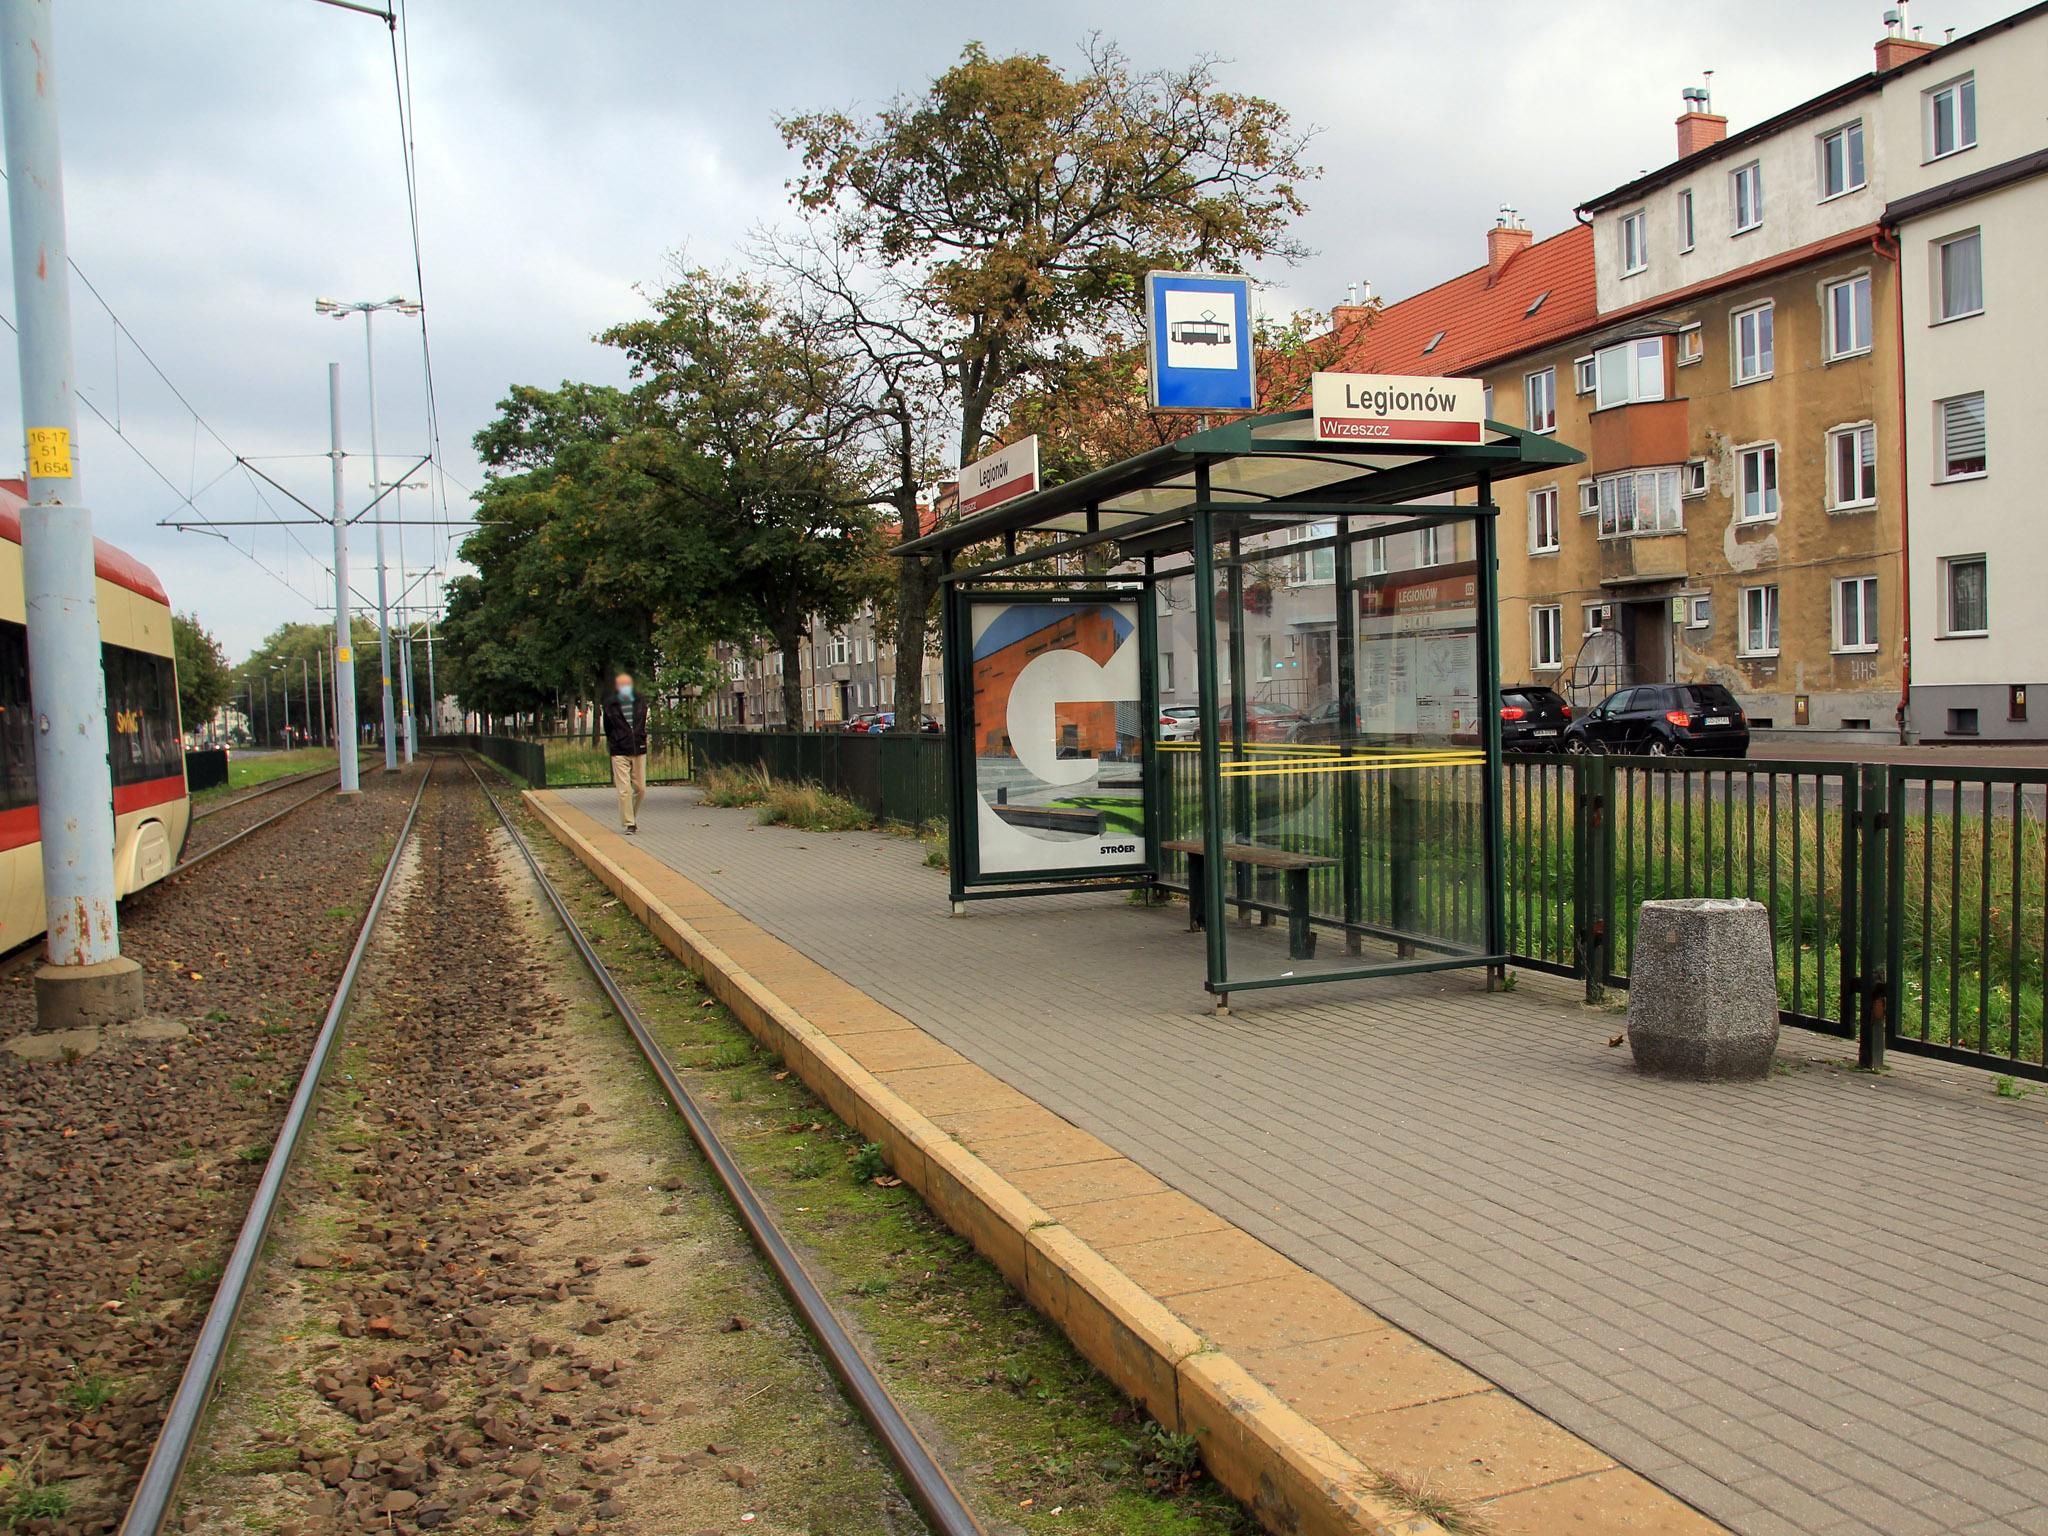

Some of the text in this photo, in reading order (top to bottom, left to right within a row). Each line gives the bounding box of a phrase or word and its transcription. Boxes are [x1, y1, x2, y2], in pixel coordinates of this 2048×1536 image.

[1345, 384, 1457, 416] Legionów
[31, 431, 67, 443] 16-17
[1322, 420, 1390, 437] Wrzeszcz
[41, 445, 57, 457] 51
[979, 457, 1009, 489] Legionów
[1398, 586, 1438, 603] LEGIONÓW
[1100, 844, 1136, 855] STRÖER
